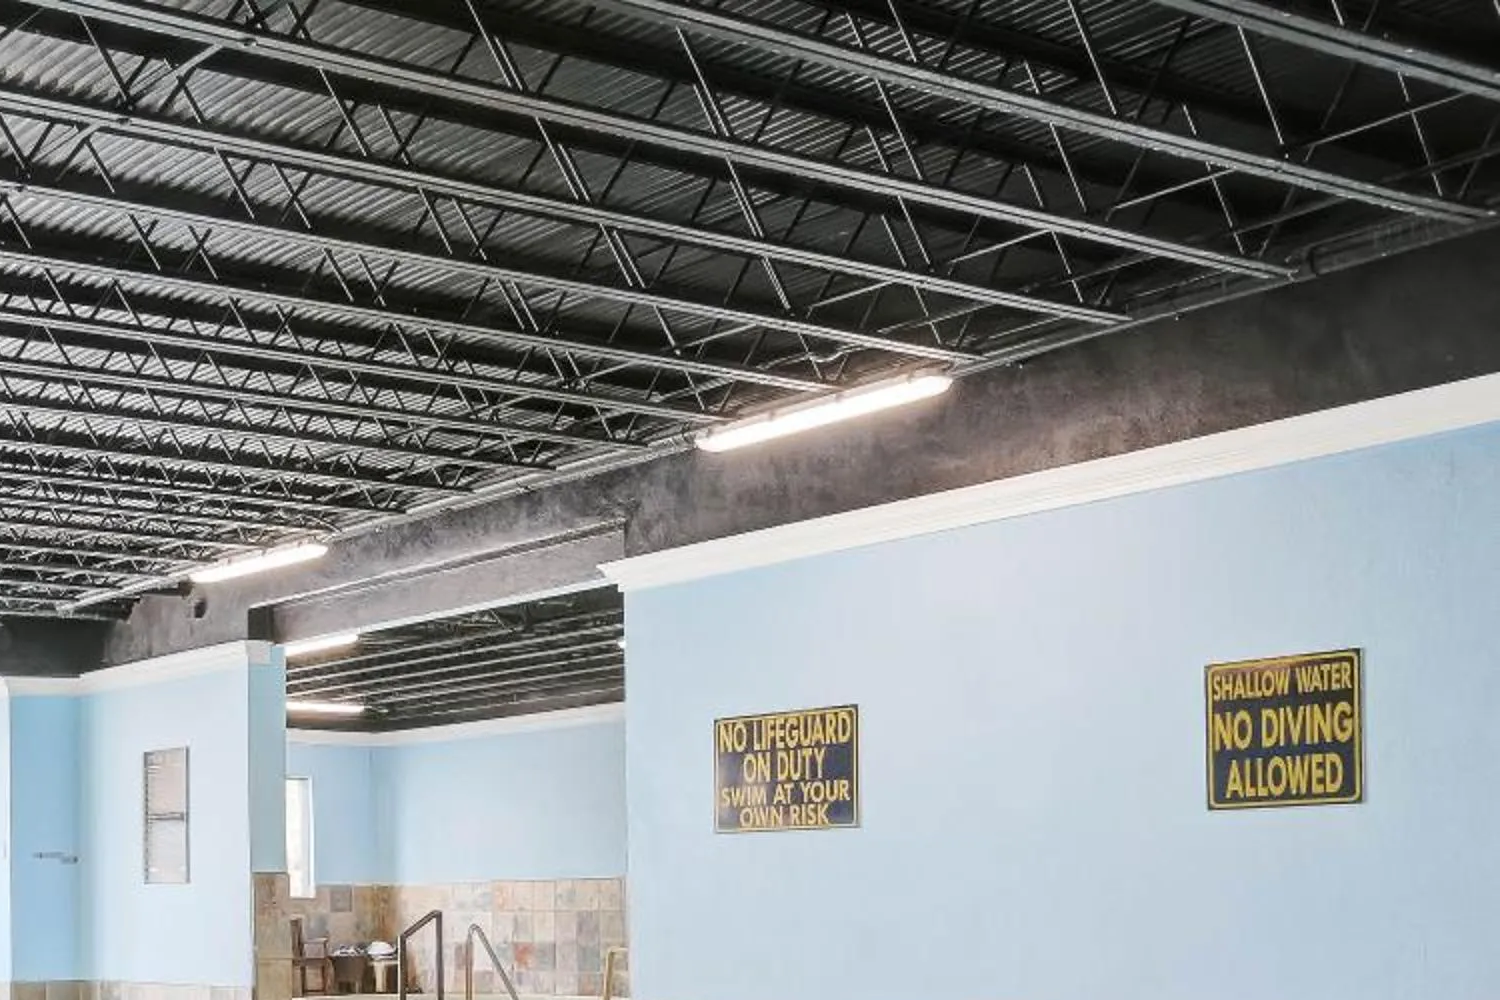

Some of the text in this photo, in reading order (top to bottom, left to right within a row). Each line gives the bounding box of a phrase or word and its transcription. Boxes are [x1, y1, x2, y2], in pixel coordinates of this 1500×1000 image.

[1213, 661, 1352, 700] SHALLOW WATER
[721, 711, 852, 753] NO LIFEGUARD
[1213, 701, 1353, 752] NO DIVING
[743, 746, 826, 783] ON DUTY
[1225, 752, 1343, 799] ALLOWED
[721, 779, 851, 808] SWIM AT YOUR
[740, 803, 829, 828] OWN RISK
